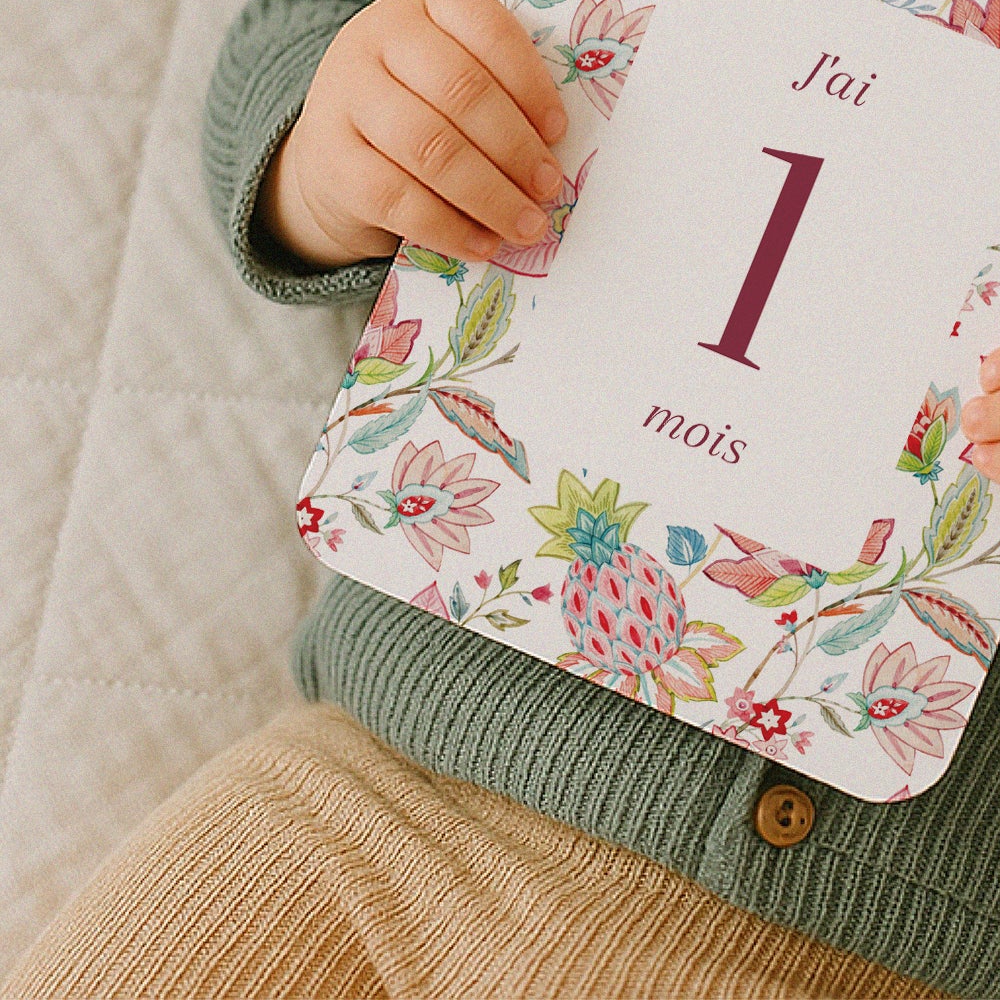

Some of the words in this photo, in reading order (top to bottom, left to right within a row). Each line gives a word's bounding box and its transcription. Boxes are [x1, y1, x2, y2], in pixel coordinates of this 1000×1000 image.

[791, 51, 877, 107] J'ai
[697, 146, 825, 371] 1
[642, 405, 747, 464] mois
